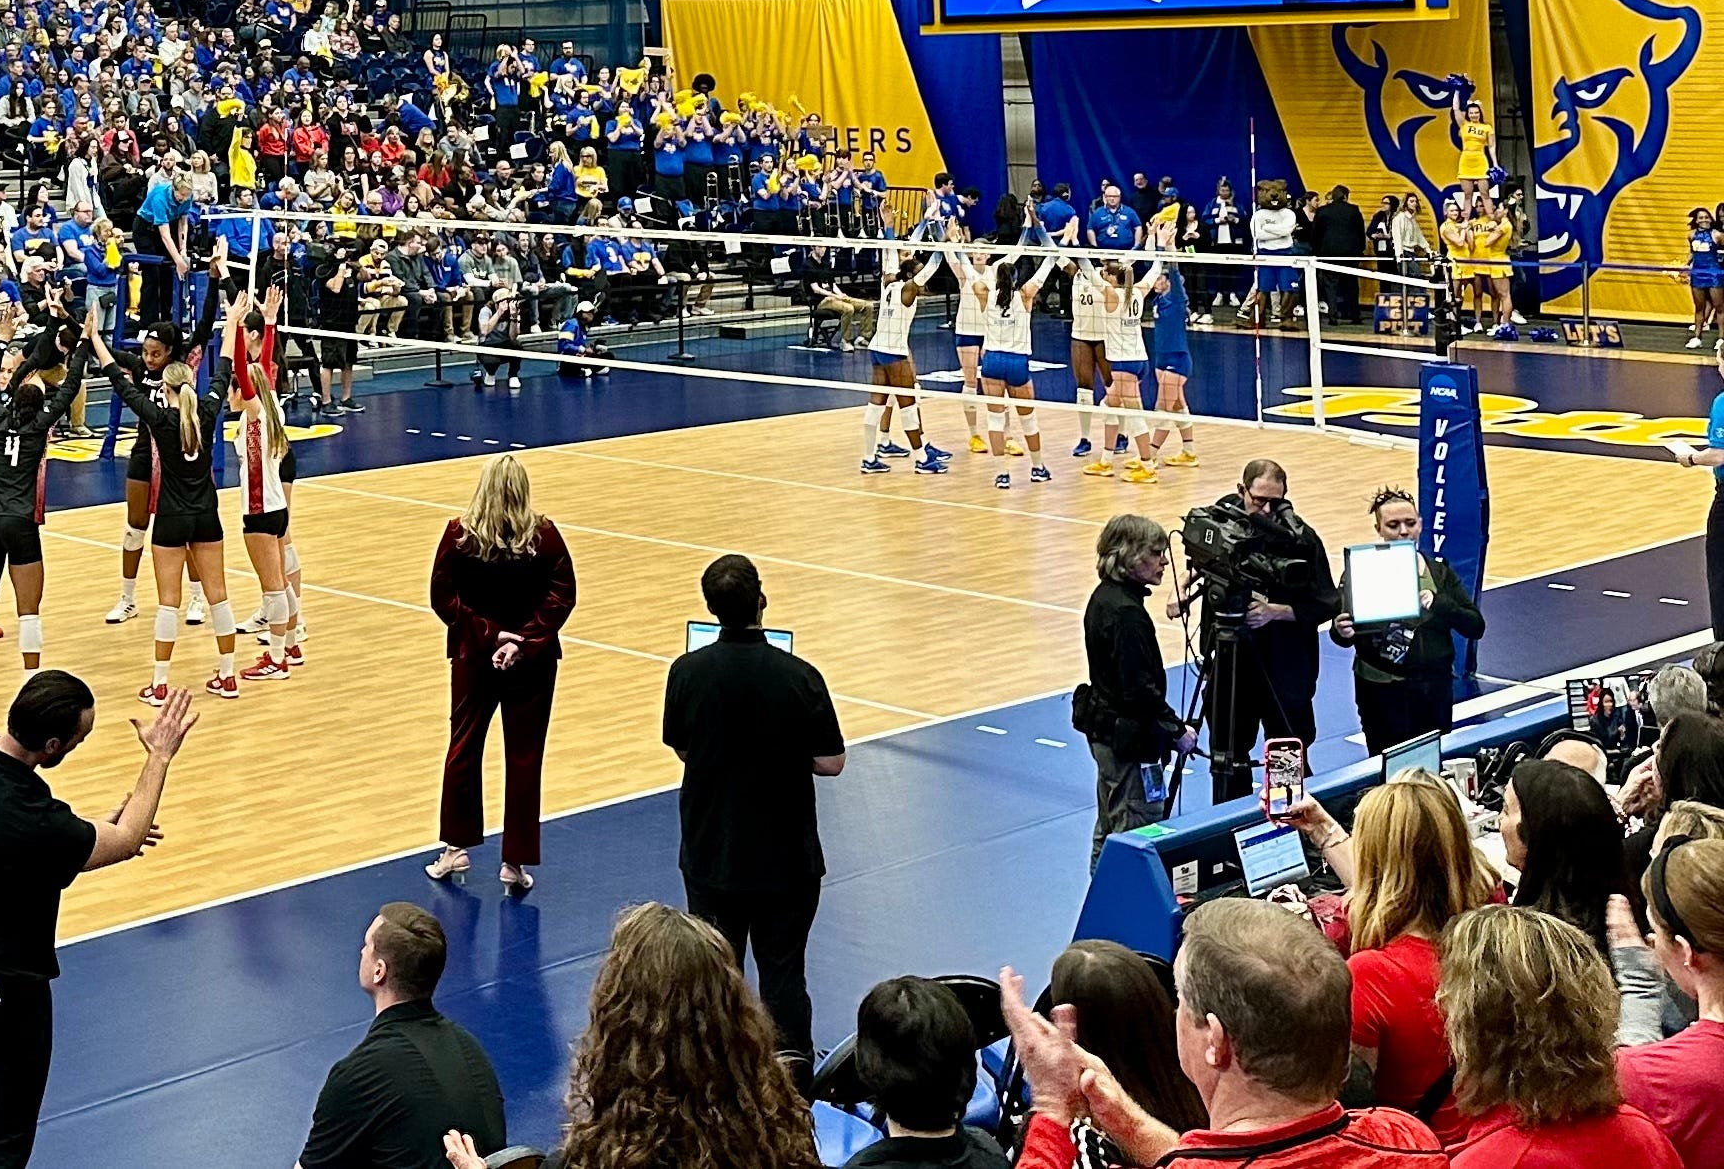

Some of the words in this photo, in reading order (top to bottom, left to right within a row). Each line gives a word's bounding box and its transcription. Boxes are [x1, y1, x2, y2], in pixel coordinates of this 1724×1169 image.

[1079, 293, 1094, 305] 20
[1429, 386, 1457, 399] NCAA
[4, 436, 20, 467] 4
[1433, 418, 1449, 562] VOLLEY
